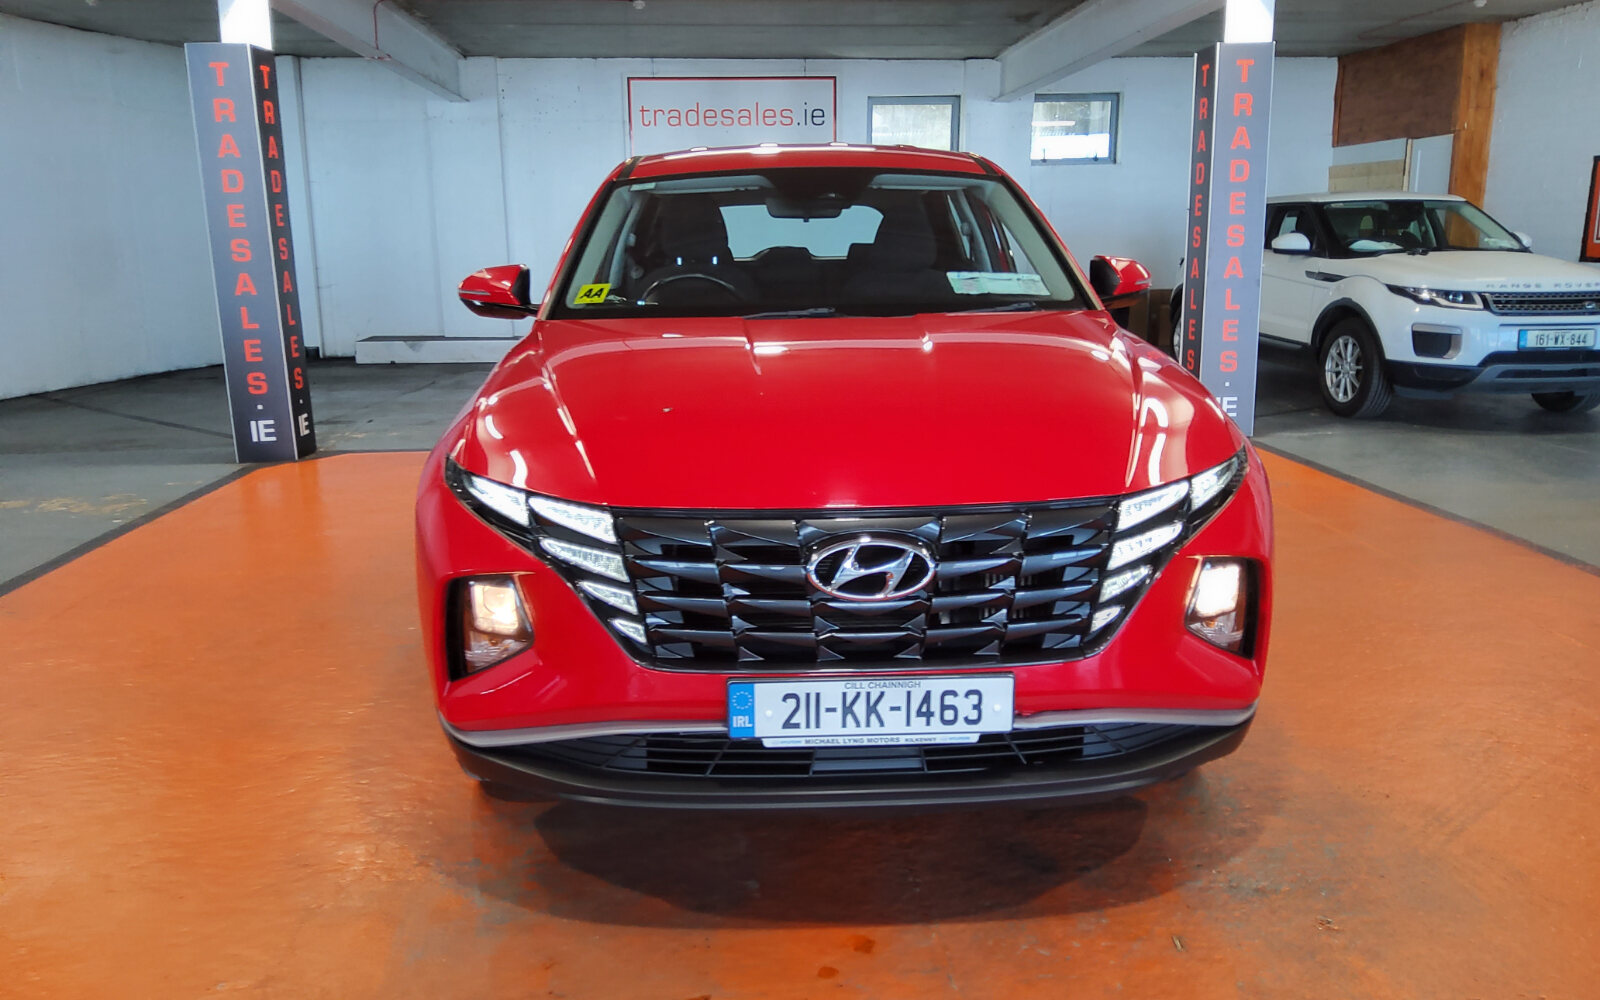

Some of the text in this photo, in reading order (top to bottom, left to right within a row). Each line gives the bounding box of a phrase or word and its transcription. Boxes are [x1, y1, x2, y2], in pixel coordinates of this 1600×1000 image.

[639, 101, 825, 127] tradesales.ie
[1187, 63, 1210, 370] TRADESALES
[1215, 58, 1255, 417] TRADESALES.E
[580, 287, 605, 299] AA
[1535, 333, 1588, 346] 161-WX-844
[844, 681, 921, 690] CILL CHAINNIGH
[781, 689, 983, 730] 211-KK-1463
[733, 715, 753, 728] IRL
